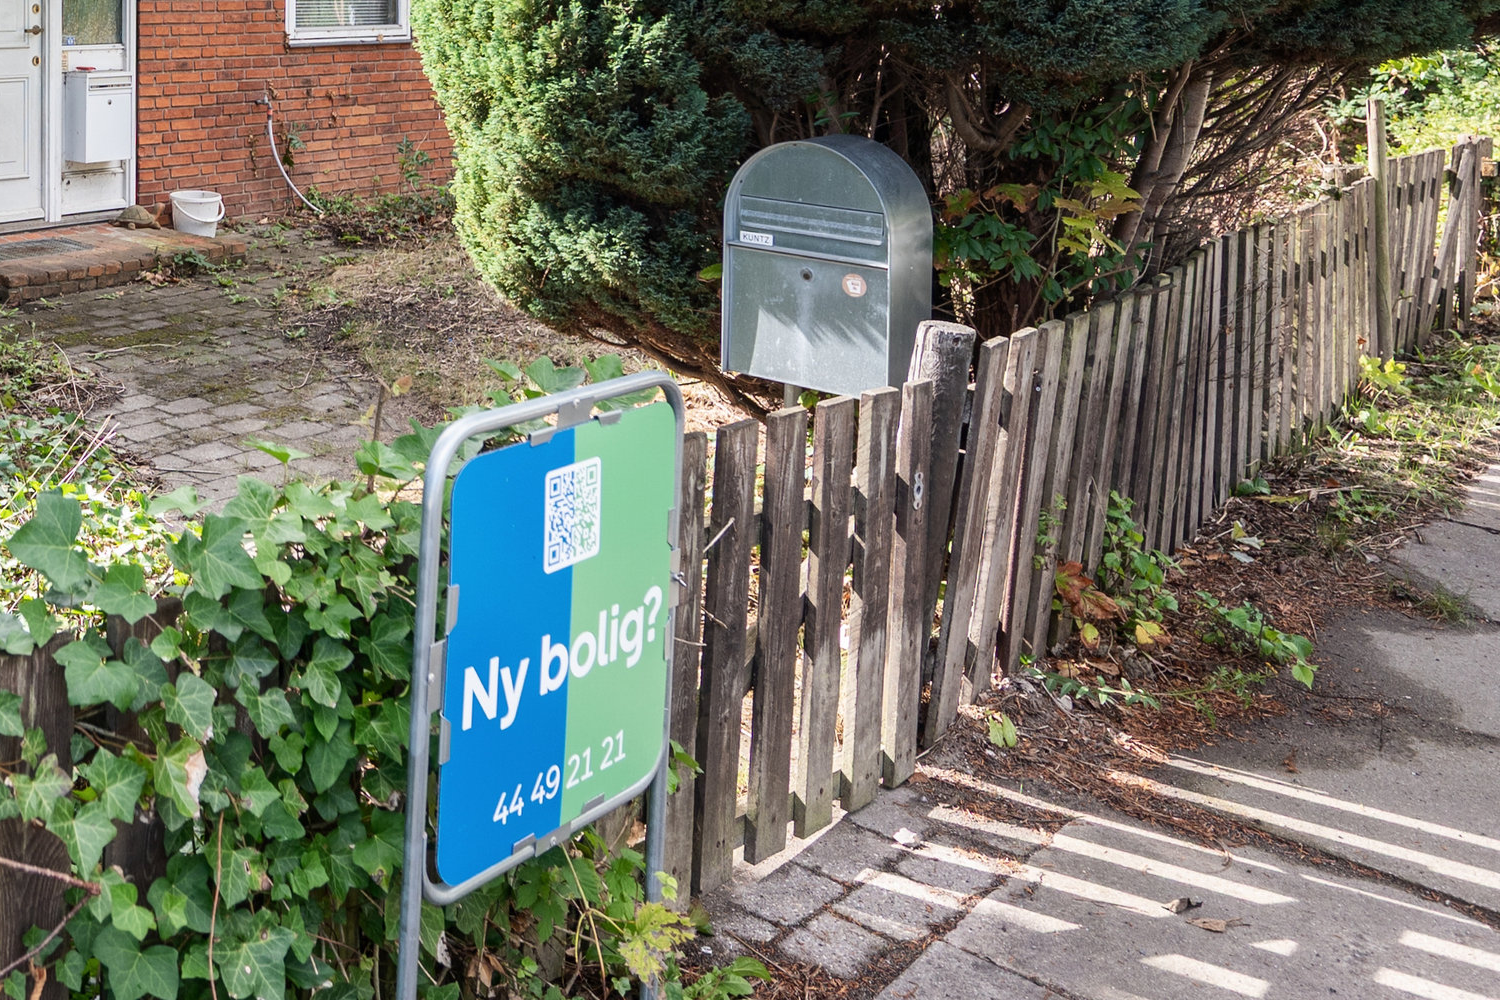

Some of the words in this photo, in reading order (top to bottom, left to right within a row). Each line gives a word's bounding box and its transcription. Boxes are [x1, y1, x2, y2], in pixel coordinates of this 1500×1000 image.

[462, 656, 530, 731] Ny
[539, 585, 663, 696] bolig?
[492, 783, 525, 825] 44
[530, 764, 561, 804] 49
[565, 746, 594, 790] 21
[600, 729, 626, 770] 21
